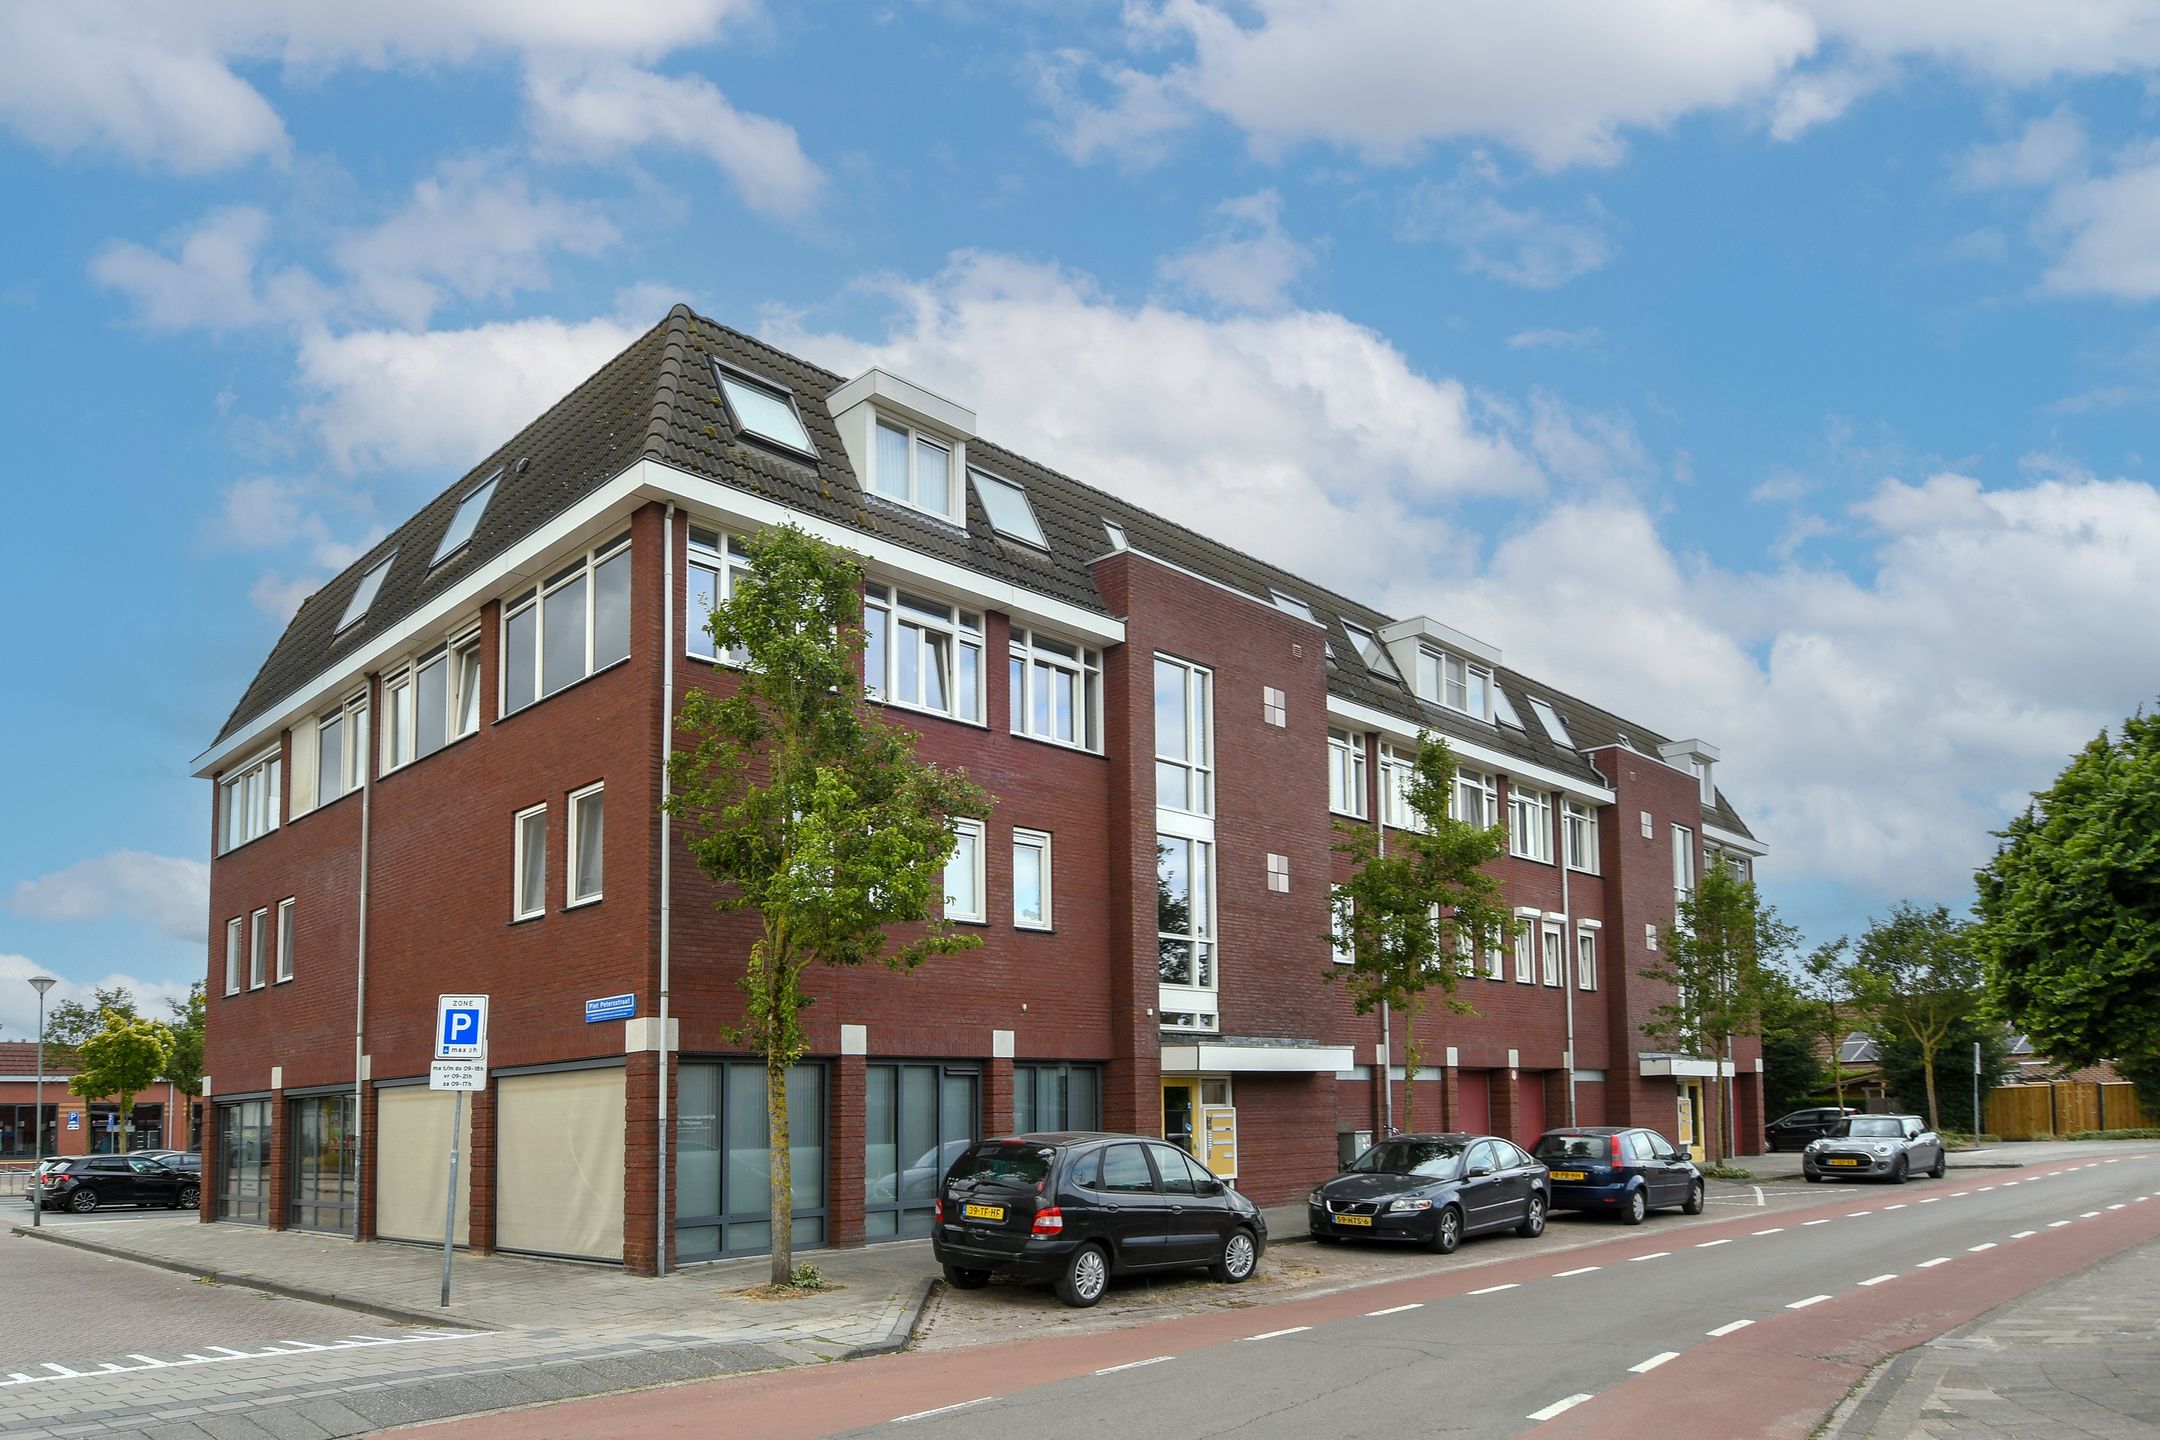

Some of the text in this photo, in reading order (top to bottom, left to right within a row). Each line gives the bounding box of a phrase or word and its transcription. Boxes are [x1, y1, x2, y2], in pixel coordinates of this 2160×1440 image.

[451, 1014, 472, 1040] P
[968, 1206, 1001, 1218] 39-TF-HF
[1336, 1216, 1369, 1225] 59-HTS-6
